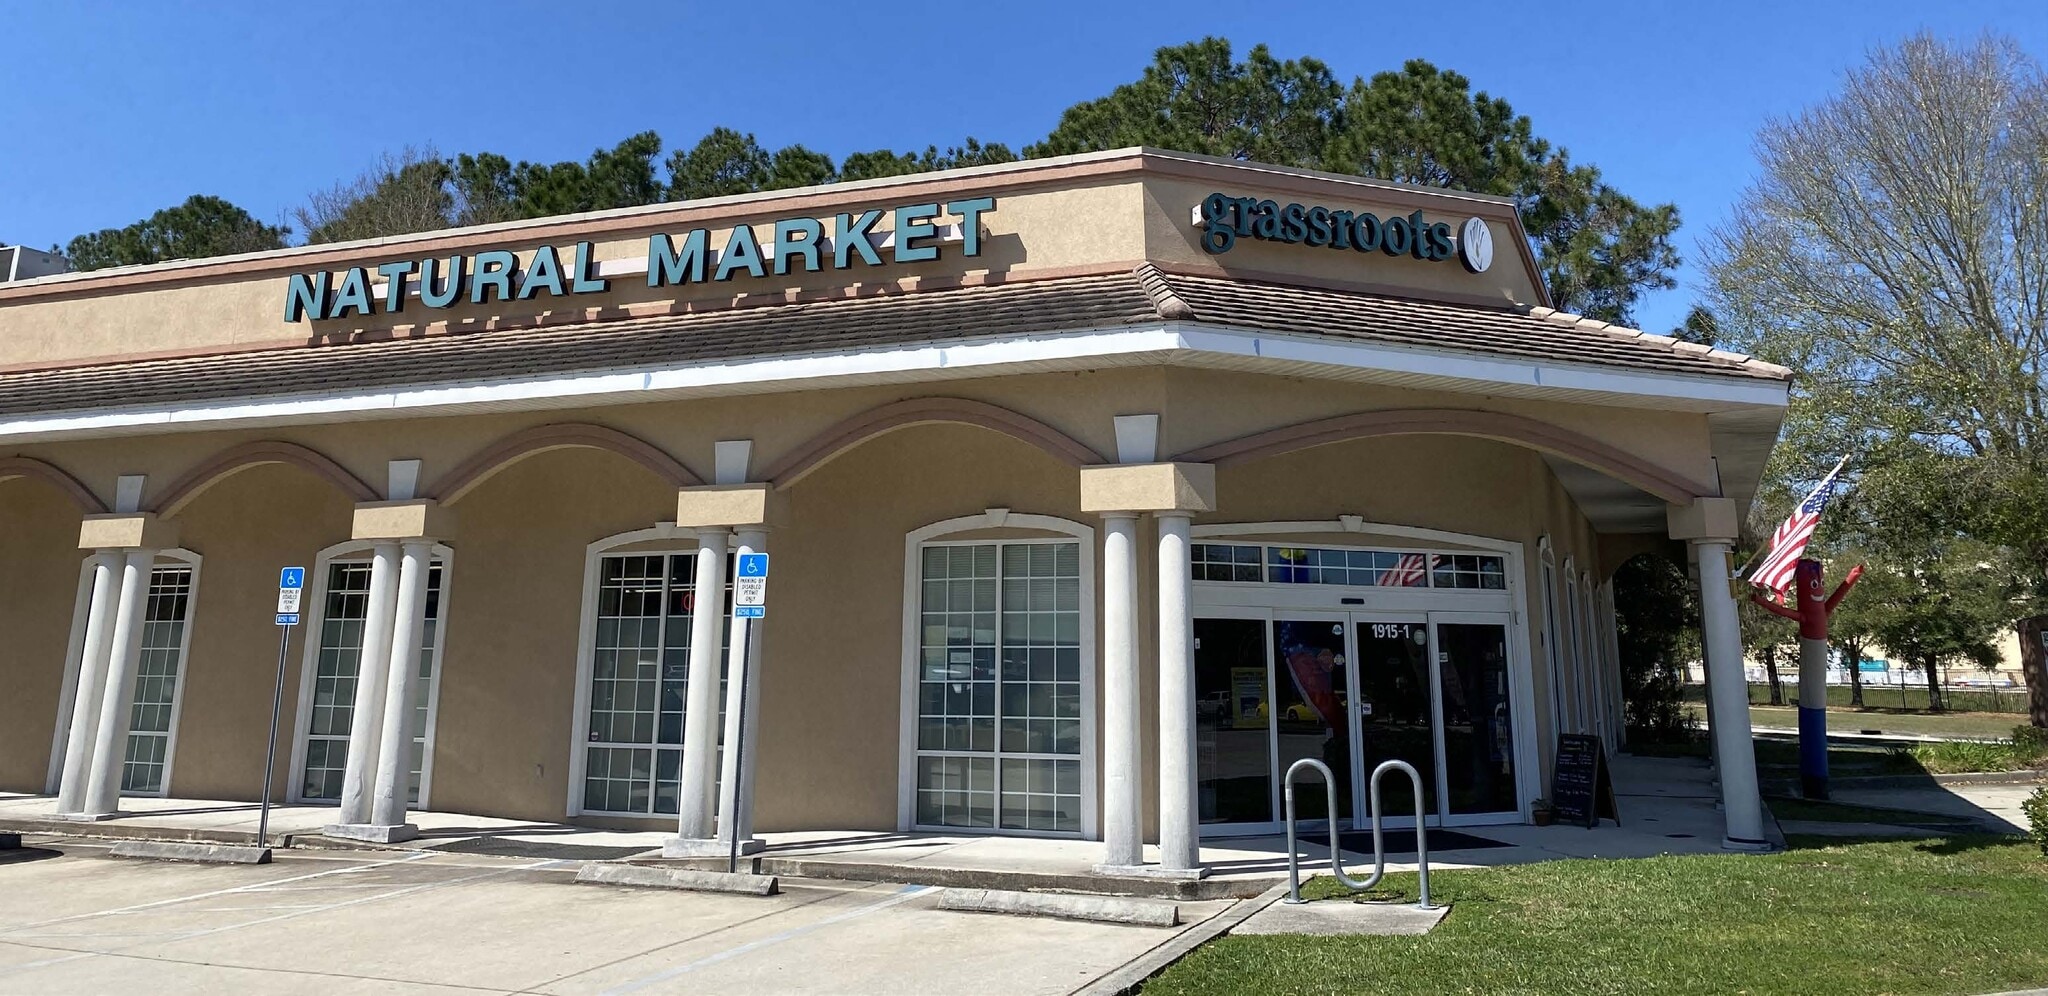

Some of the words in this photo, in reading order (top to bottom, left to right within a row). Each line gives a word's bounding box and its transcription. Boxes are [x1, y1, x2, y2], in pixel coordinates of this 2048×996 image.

[284, 240, 610, 323] NATURAL
[647, 197, 997, 288] MARKET
[1200, 192, 1454, 262] grassroots
[1372, 624, 1409, 639] 1915-1
